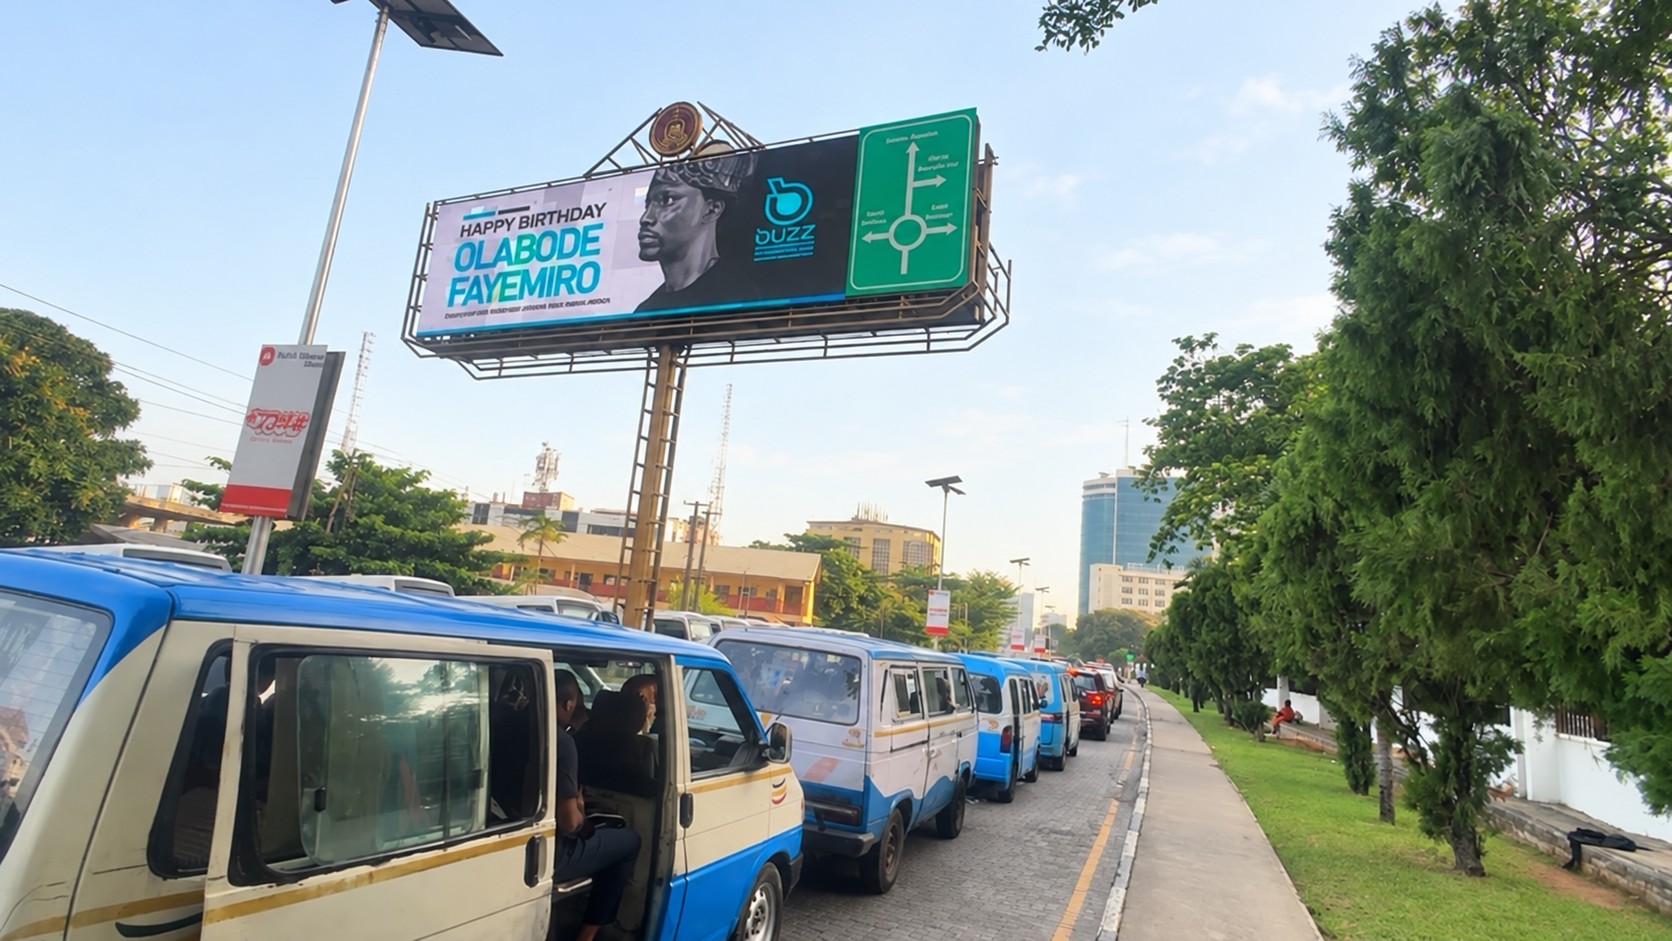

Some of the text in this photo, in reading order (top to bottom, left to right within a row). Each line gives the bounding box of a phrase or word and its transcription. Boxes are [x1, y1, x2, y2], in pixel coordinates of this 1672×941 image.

[460, 202, 607, 238] HAPPY BIRTHDAY
[454, 223, 604, 272] OLABODE
[447, 260, 601, 307] FAYEMIRO
